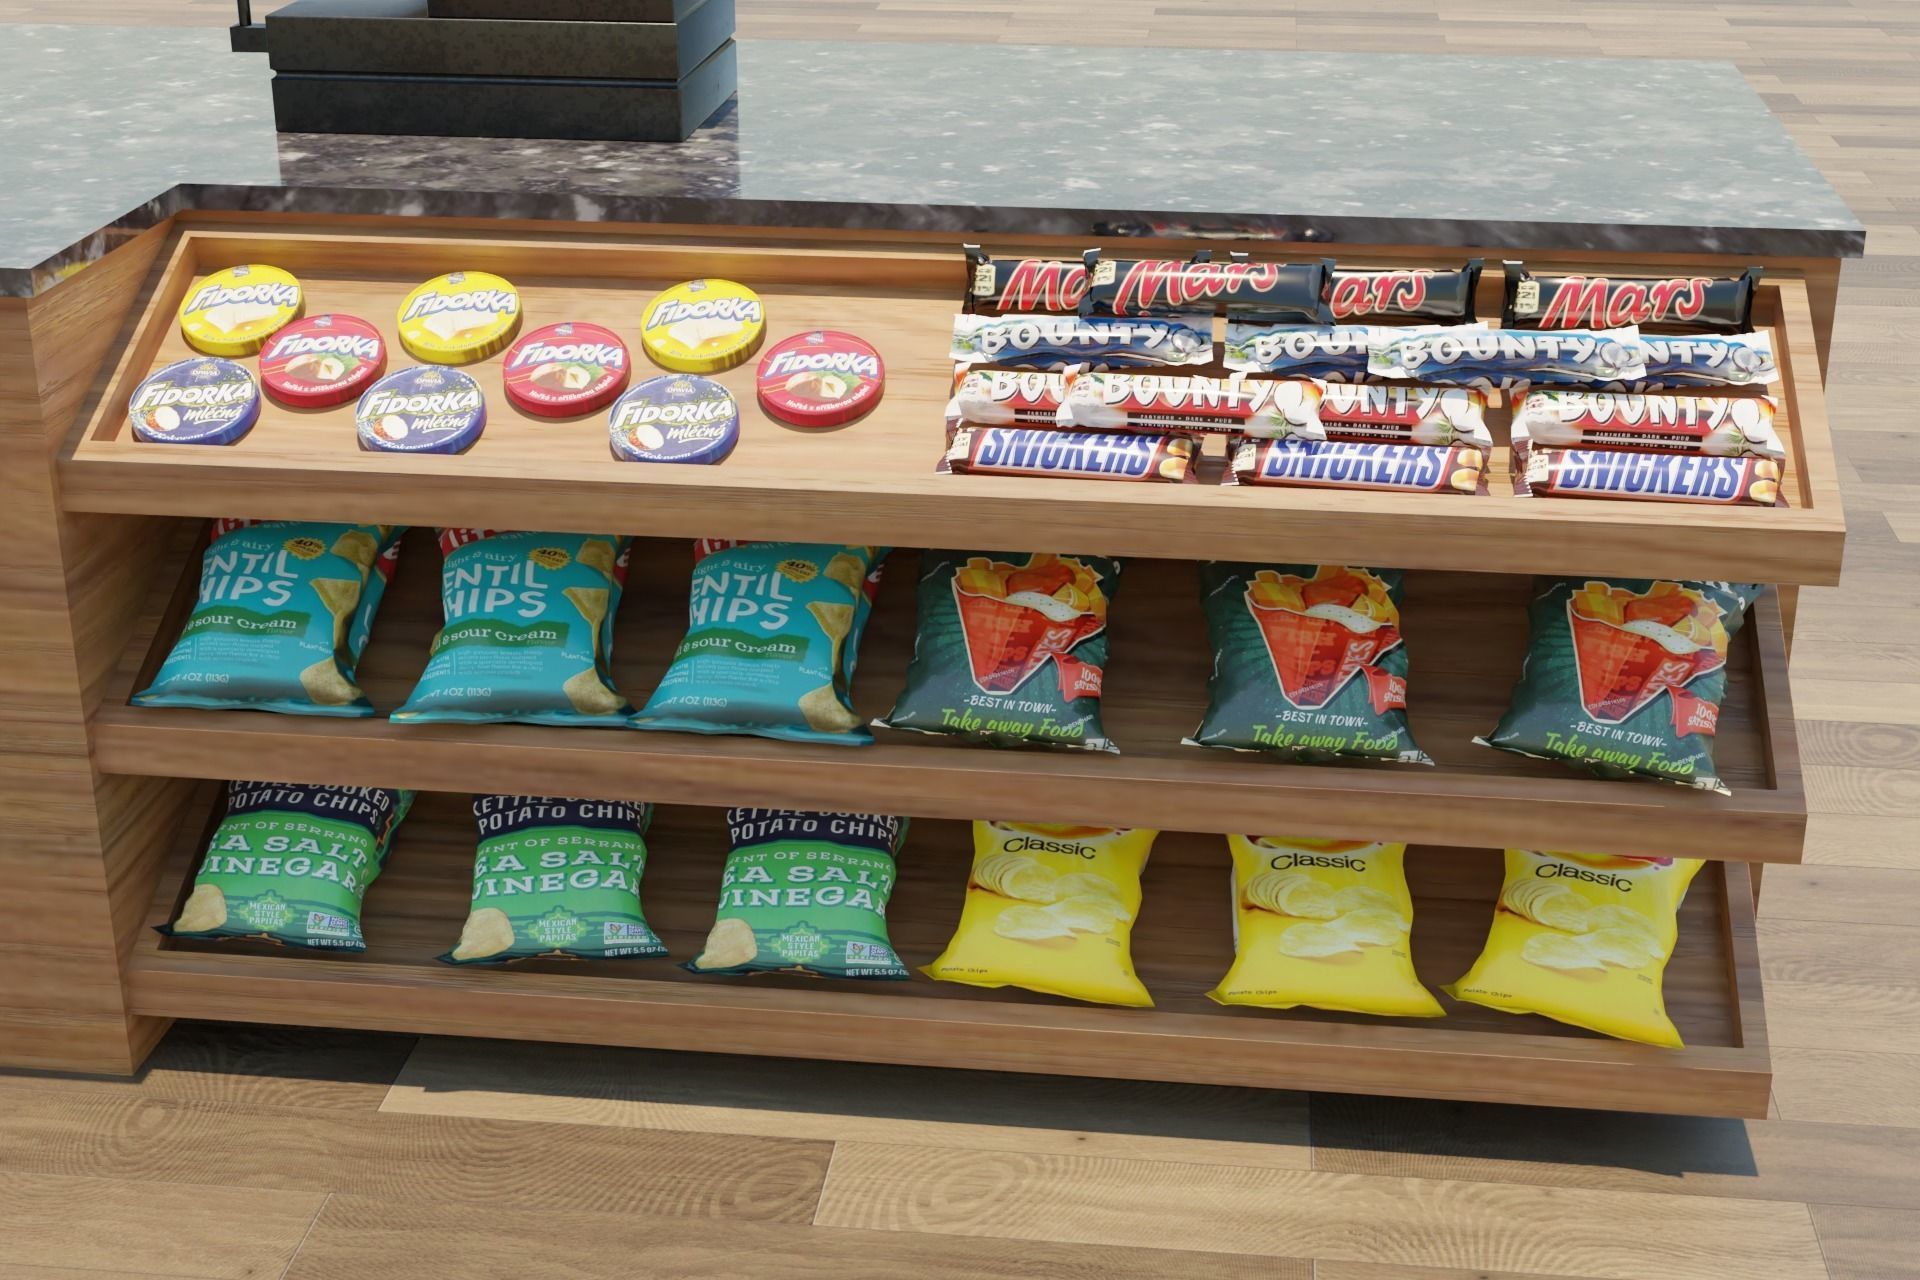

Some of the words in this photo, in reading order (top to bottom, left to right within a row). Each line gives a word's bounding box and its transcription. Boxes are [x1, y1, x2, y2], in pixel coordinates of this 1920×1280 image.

[997, 259, 1091, 311] Ma
[1112, 260, 1286, 316] Mars
[1329, 269, 1435, 319] ars
[1538, 276, 1714, 329] Mars
[982, 322, 1170, 355] BOUNTY
[1400, 335, 1598, 370] BOUNTY
[1640, 338, 1729, 369] NTY
[1104, 375, 1276, 413] BOUNTY
[1559, 392, 1729, 432] BOUNTY
[978, 428, 1162, 476] SNICKERS
[1265, 439, 1448, 487] SNICKERS
[1558, 450, 1747, 499] SNICKERS
[443, 559, 548, 591] ENTIL
[692, 571, 793, 602] ENTIL
[200, 575, 295, 607] HIPS
[443, 588, 547, 619] HIPS
[691, 597, 790, 630] HIPS
[1003, 699, 1014, 711] IN
[1315, 714, 1326, 725] IN
[942, 707, 982, 732] Take
[986, 720, 1035, 738] away
[1611, 727, 1624, 741] IN
[1252, 723, 1294, 747] Take
[1298, 735, 1347, 753] away
[1546, 732, 1588, 758] Take
[1592, 747, 1642, 771] away
[228, 789, 304, 811] POTATO
[313, 792, 378, 825] CHIPS
[478, 805, 566, 835] POTATO
[256, 821, 279, 831] OF
[284, 823, 369, 848] SERRANO
[524, 838, 551, 847] OF
[731, 819, 818, 845] POTATO
[263, 836, 368, 870] SALT
[774, 852, 800, 860] OF
[1003, 836, 1097, 860] Classic
[1270, 853, 1367, 872] Classic
[475, 854, 526, 879] EA
[540, 850, 643, 876] SALT
[1535, 863, 1633, 893] Classic
[722, 865, 774, 888] EA
[787, 866, 892, 895] SALT
[249, 902, 286, 911] MEXICAN
[254, 910, 280, 918] STYLE
[539, 919, 577, 927] MEXICAN
[540, 933, 577, 942] PAPITAS
[307, 938, 319, 946] NET
[333, 939, 344, 947] 5.5
[604, 949, 618, 957] NET
[619, 948, 631, 956] WT
[782, 934, 820, 943] MEXICAN
[782, 949, 819, 958] PAPITAS
[787, 942, 815, 950] STYLE
[846, 968, 860, 976] NET
[861, 968, 873, 976] WT
